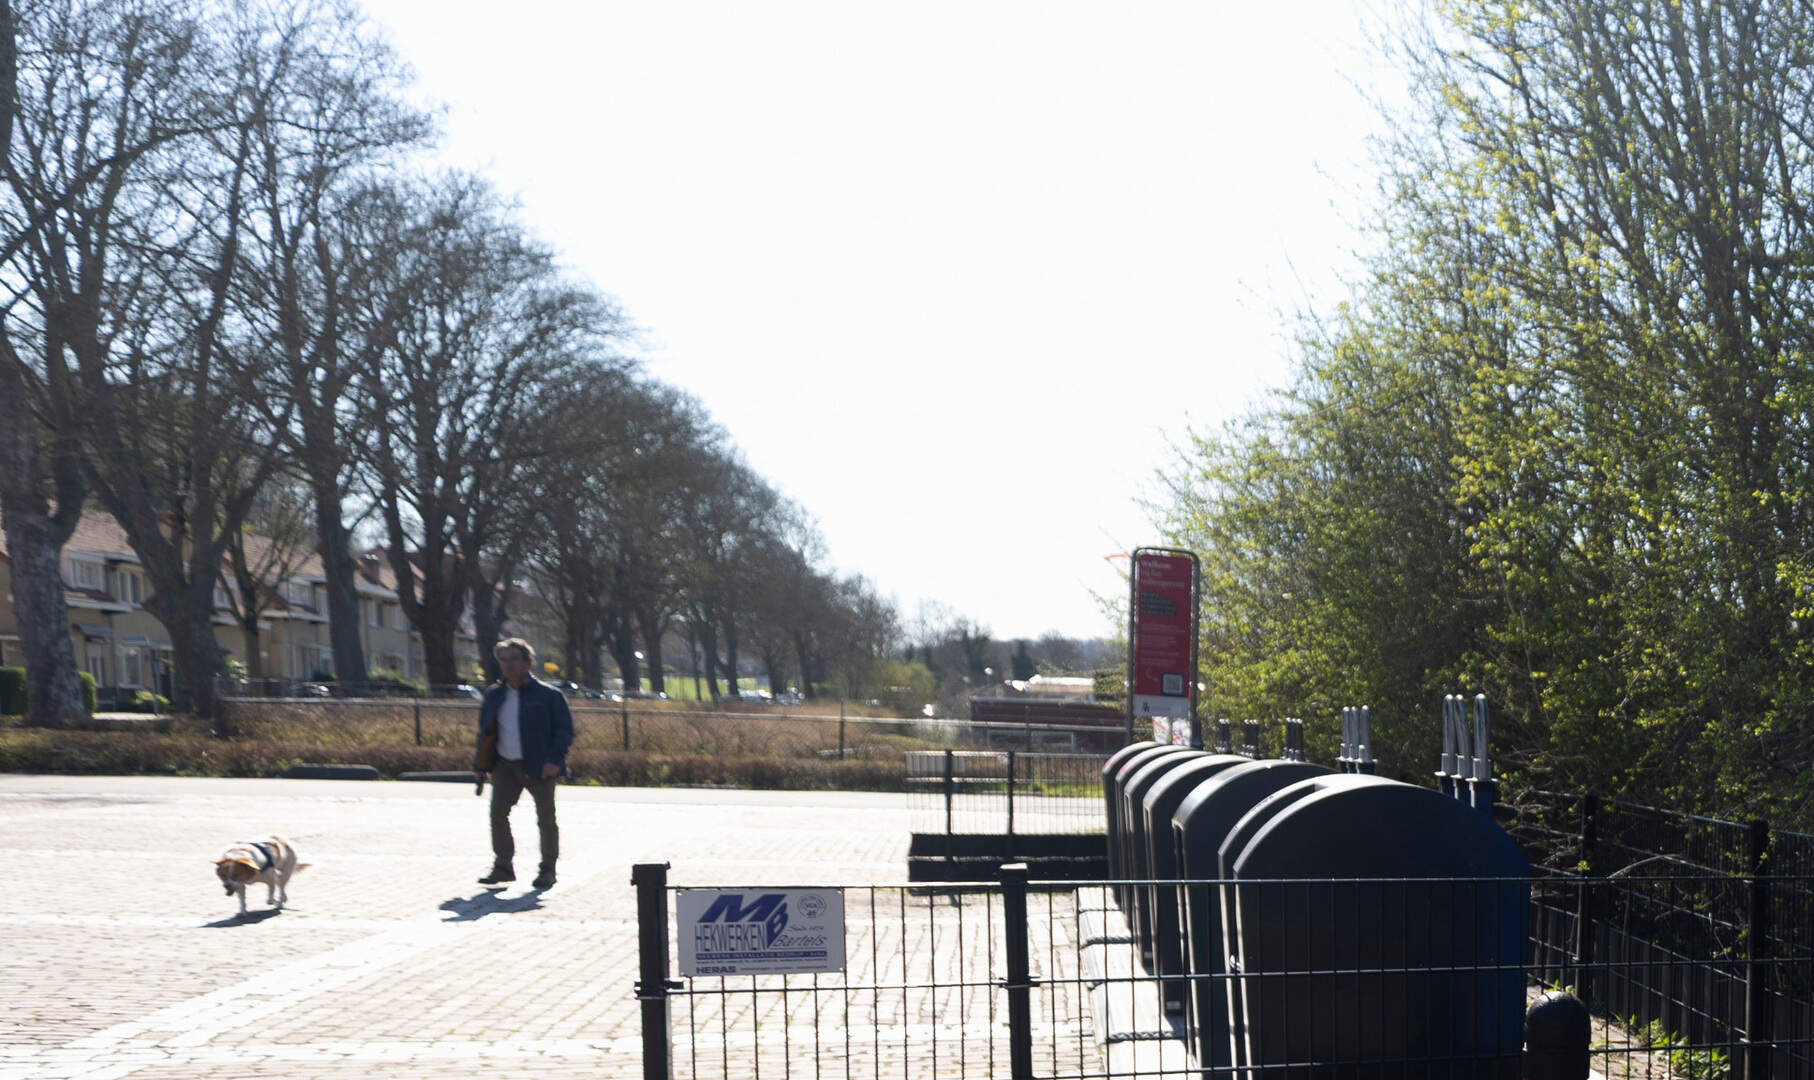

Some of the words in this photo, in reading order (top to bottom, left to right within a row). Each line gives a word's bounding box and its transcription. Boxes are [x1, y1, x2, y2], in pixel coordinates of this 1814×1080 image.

[695, 923, 767, 952] HEKWERKEN
[774, 934, 828, 947] Bartels
[696, 966, 736, 974] HERAS
